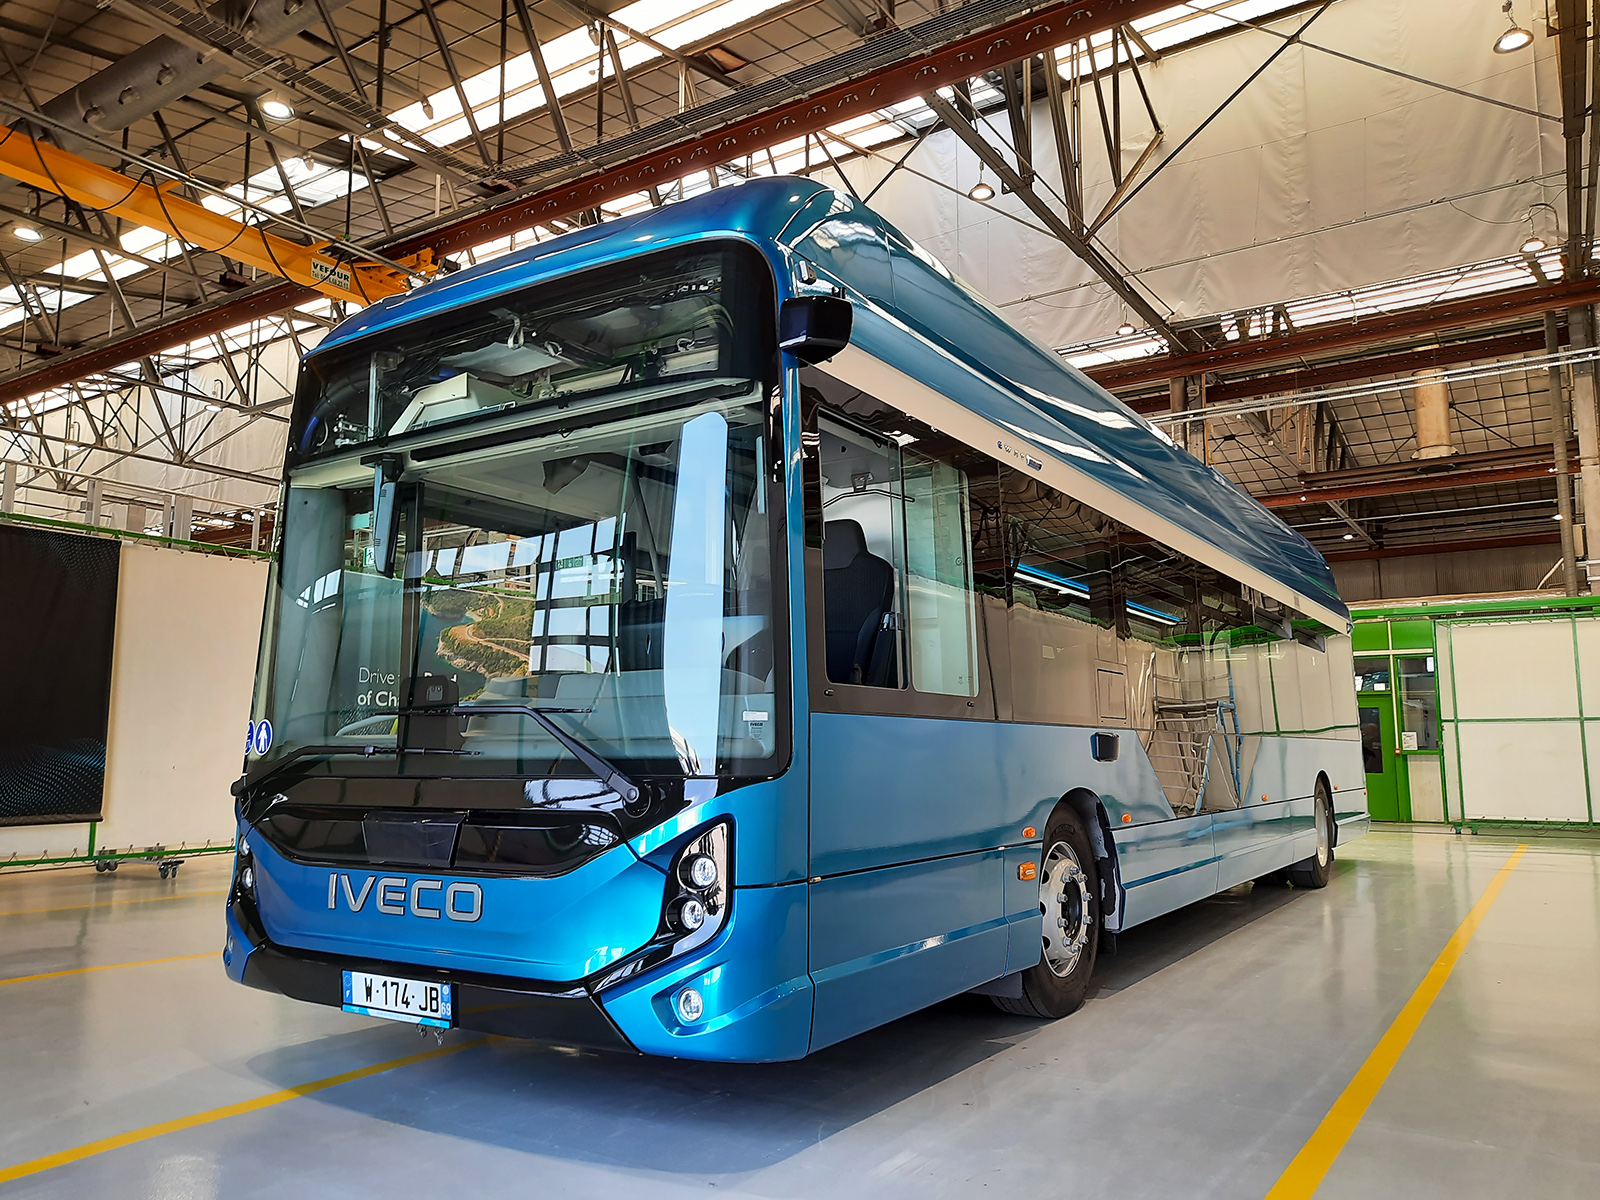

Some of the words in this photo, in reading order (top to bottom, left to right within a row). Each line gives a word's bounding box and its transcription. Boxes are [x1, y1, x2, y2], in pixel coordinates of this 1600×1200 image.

[358, 667, 395, 685] Drive
[357, 690, 373, 706] of
[375, 691, 399, 707] Ch
[328, 873, 483, 922] IVECO
[441, 1002, 452, 1016] 69
